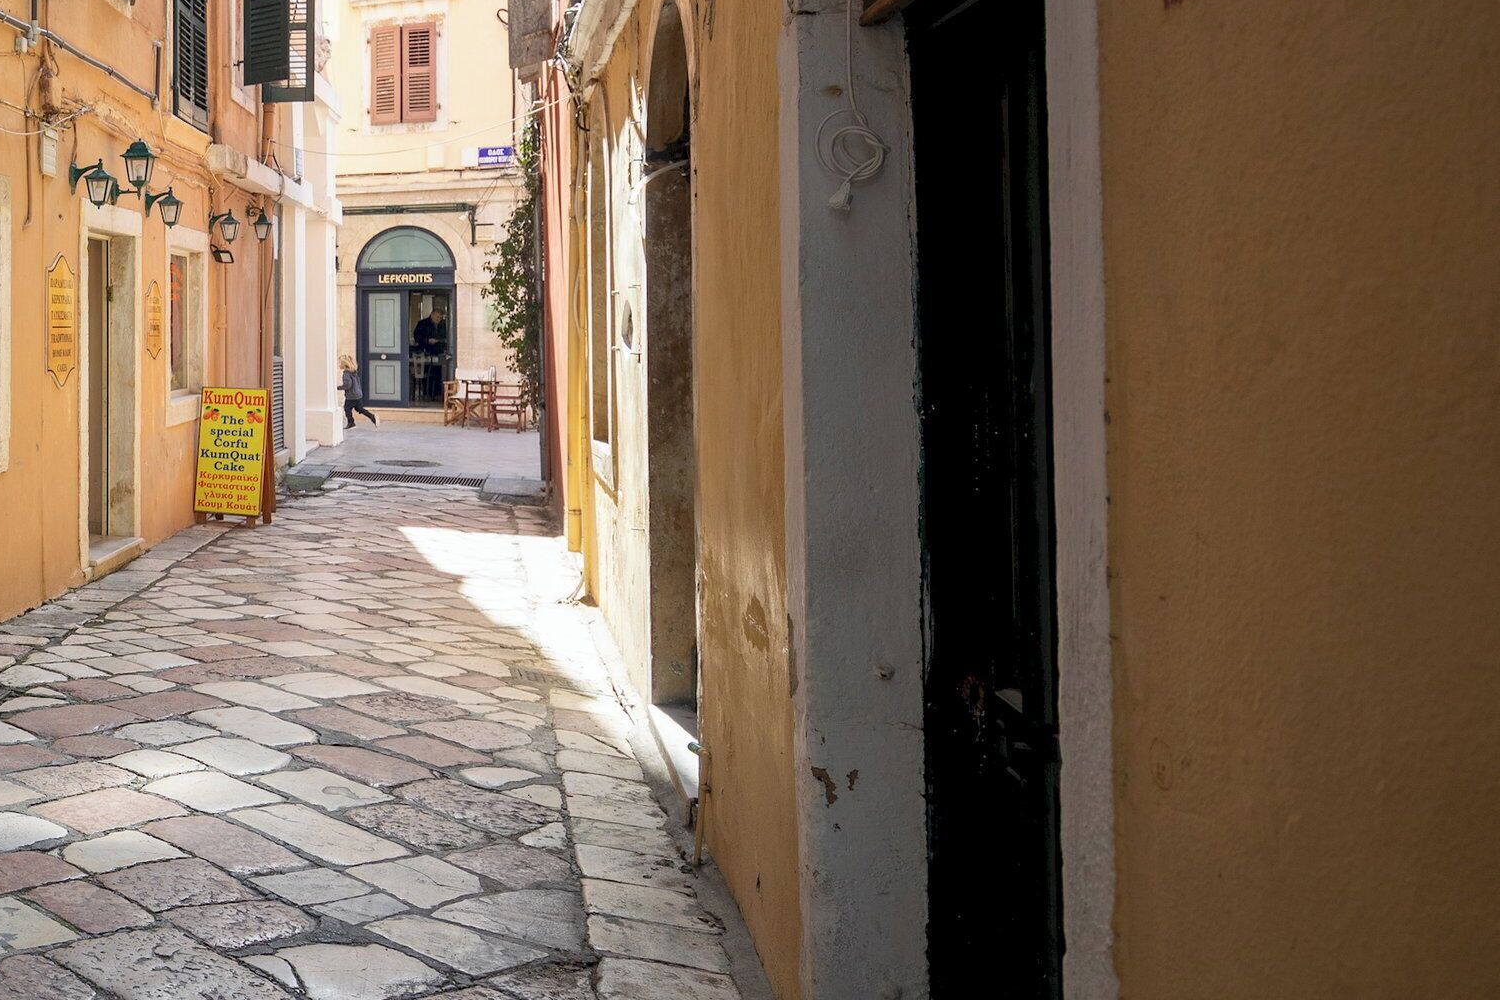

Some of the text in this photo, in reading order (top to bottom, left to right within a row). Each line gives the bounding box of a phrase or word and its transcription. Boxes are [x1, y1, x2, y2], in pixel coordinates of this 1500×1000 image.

[378, 273, 433, 284] LEFKADITIS
[203, 390, 265, 408] KumQum
[221, 415, 244, 425] The
[210, 428, 254, 438] special
[213, 438, 248, 449] Corfu
[200, 449, 260, 462] KumQuat
[214, 461, 245, 472] Cake
[203, 490, 234, 501] γλυκό
